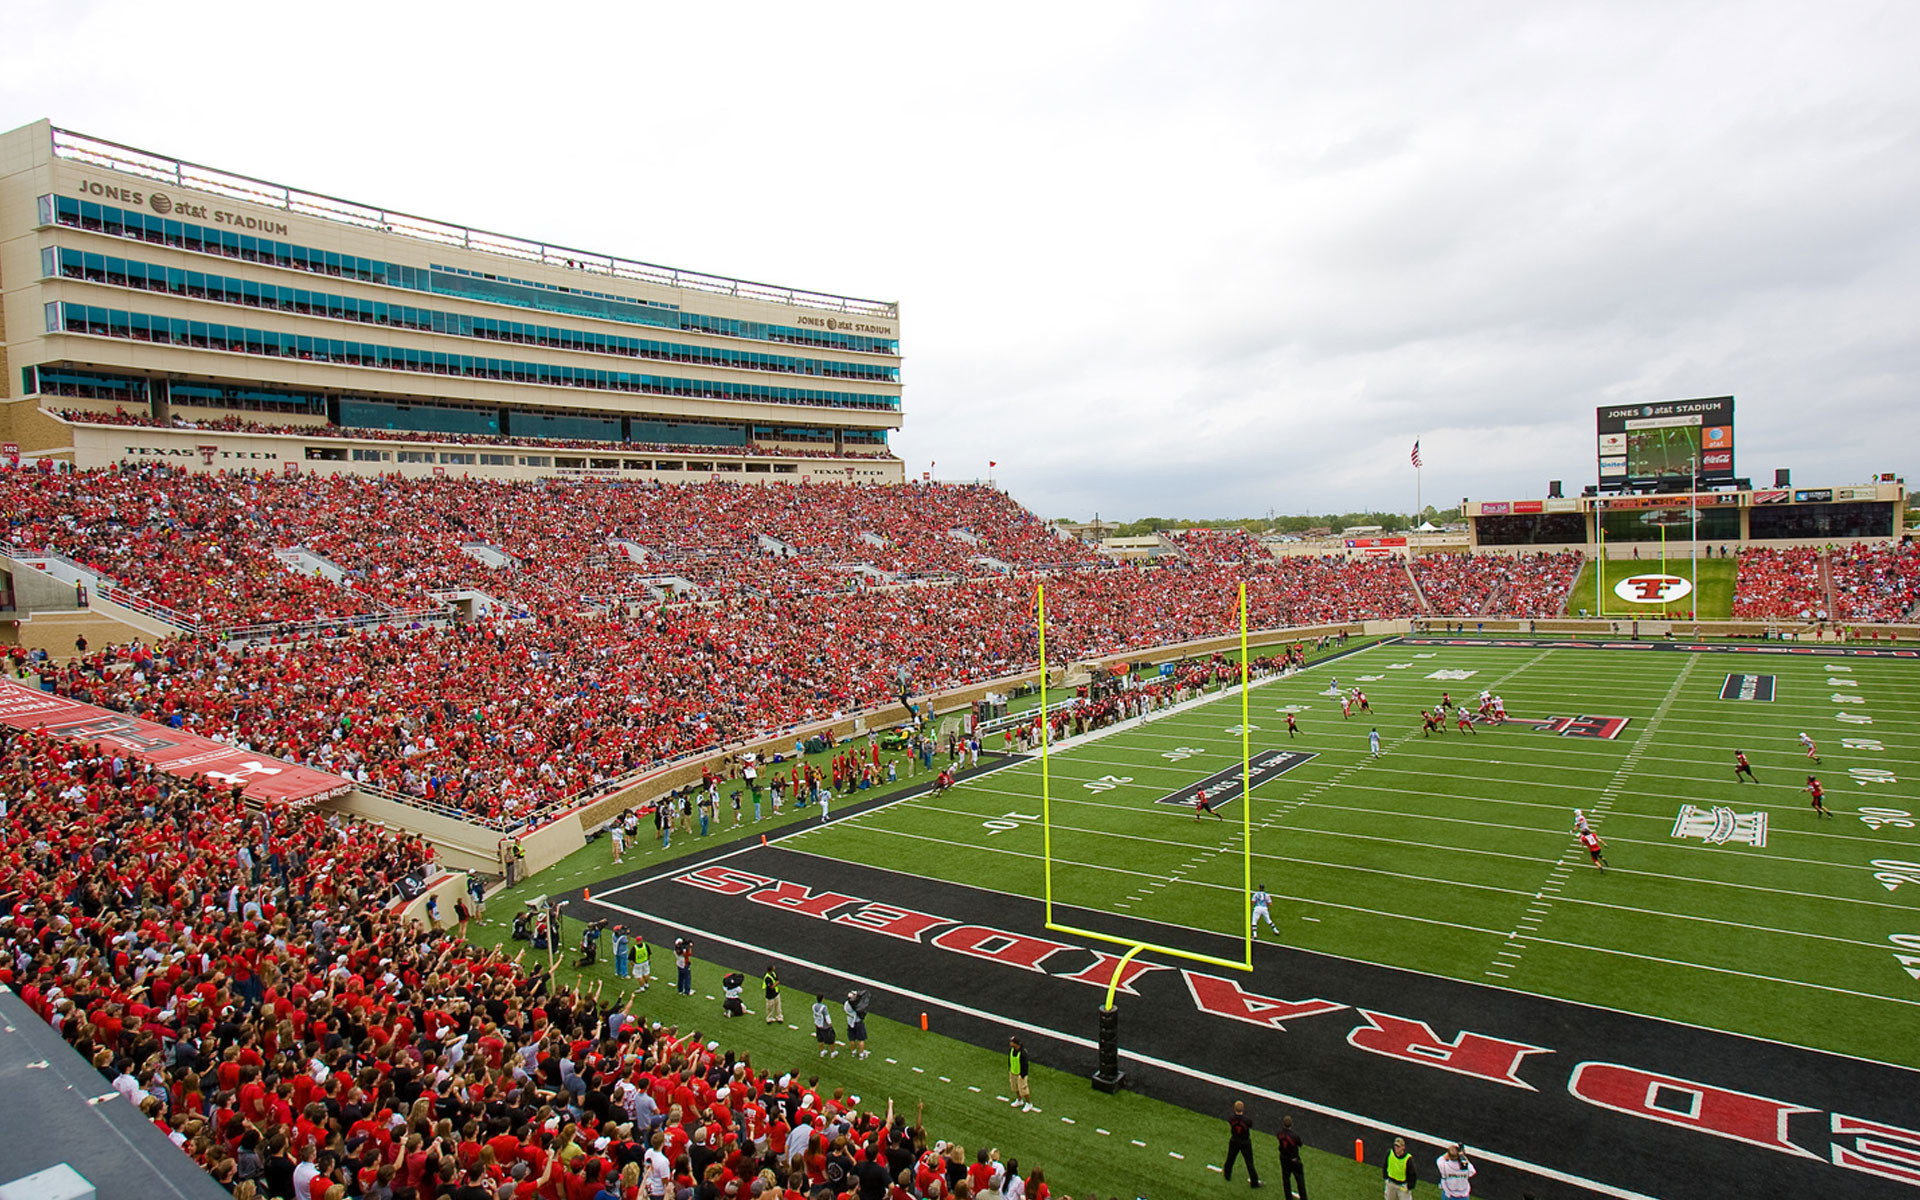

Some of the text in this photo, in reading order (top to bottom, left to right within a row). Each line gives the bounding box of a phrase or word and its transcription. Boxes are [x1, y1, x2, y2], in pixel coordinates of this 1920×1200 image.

[79, 180, 288, 236] JONES at&t STADIUM
[797, 316, 891, 335] JONES at&t STADIUM
[1608, 402, 1722, 419] JONES at&t STADIUM
[1708, 440, 1724, 448] at&t
[125, 446, 194, 457] TEXAS
[220, 451, 278, 460] TECH
[1601, 461, 1626, 469] United
[1083, 774, 1134, 791] 20
[981, 810, 1042, 831] 10
[1857, 806, 1916, 828] 30
[671, 864, 1557, 1093] RAIDERS
[709, 1132, 717, 1145] 6
